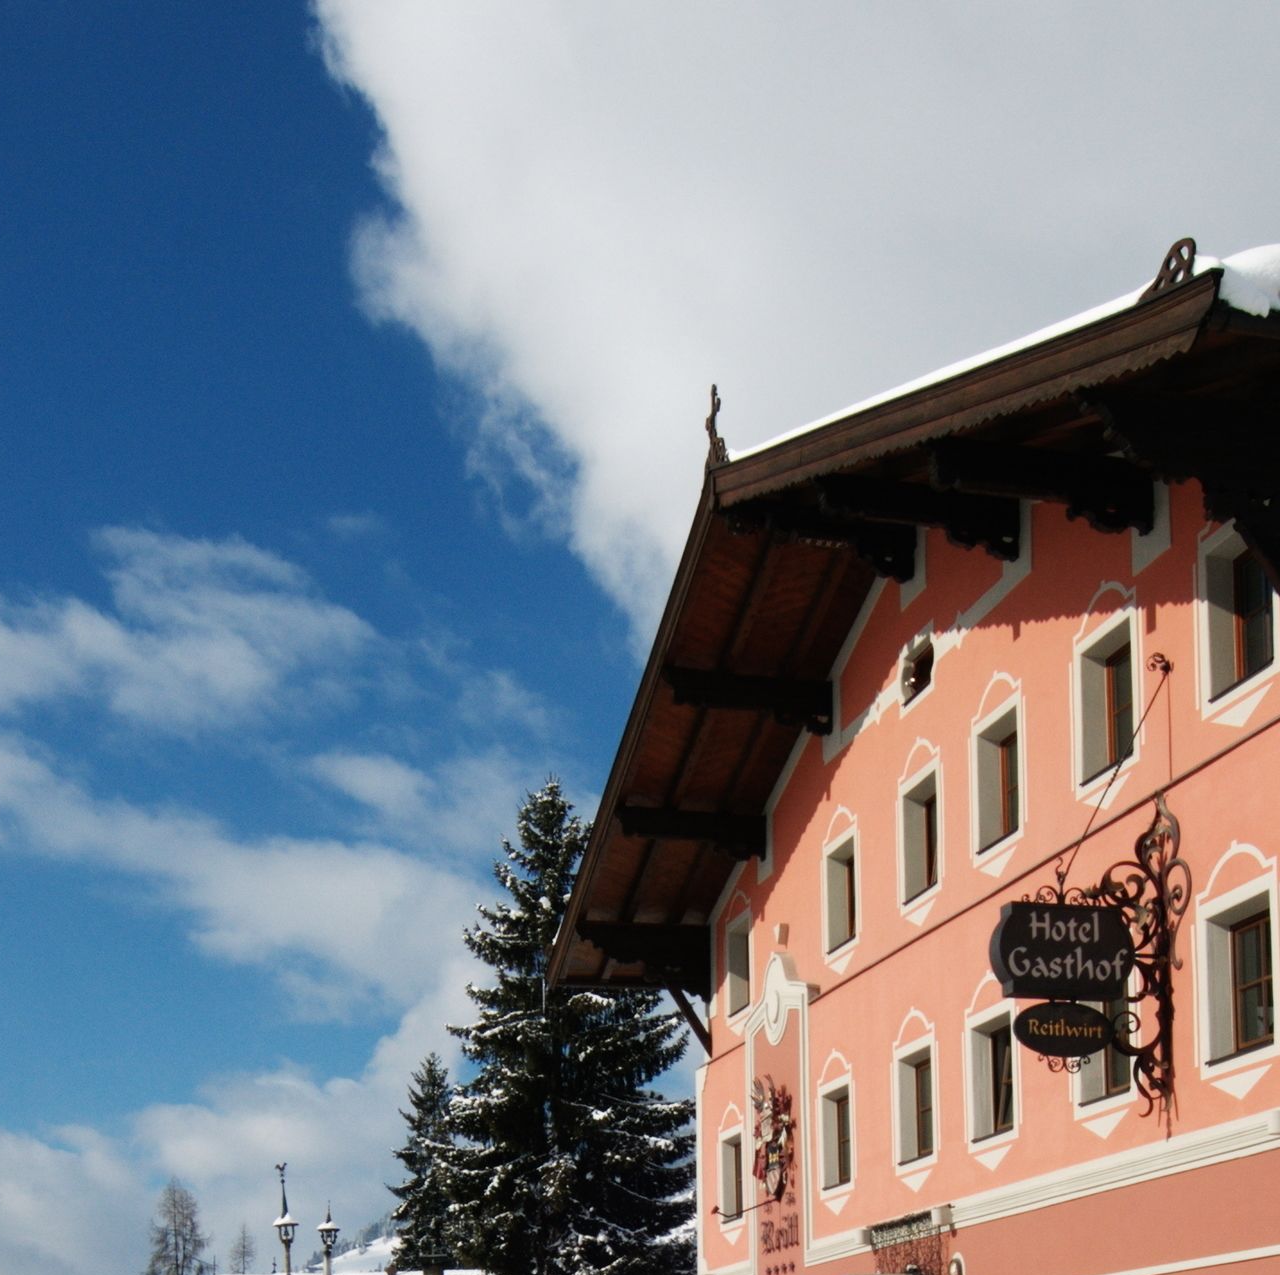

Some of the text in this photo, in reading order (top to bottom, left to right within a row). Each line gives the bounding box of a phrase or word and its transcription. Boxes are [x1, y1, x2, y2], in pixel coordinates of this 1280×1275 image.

[1029, 910, 1100, 943] Hotel
[1008, 946, 1128, 981] Gasthof
[1028, 1018, 1104, 1039] Reitlwirt
